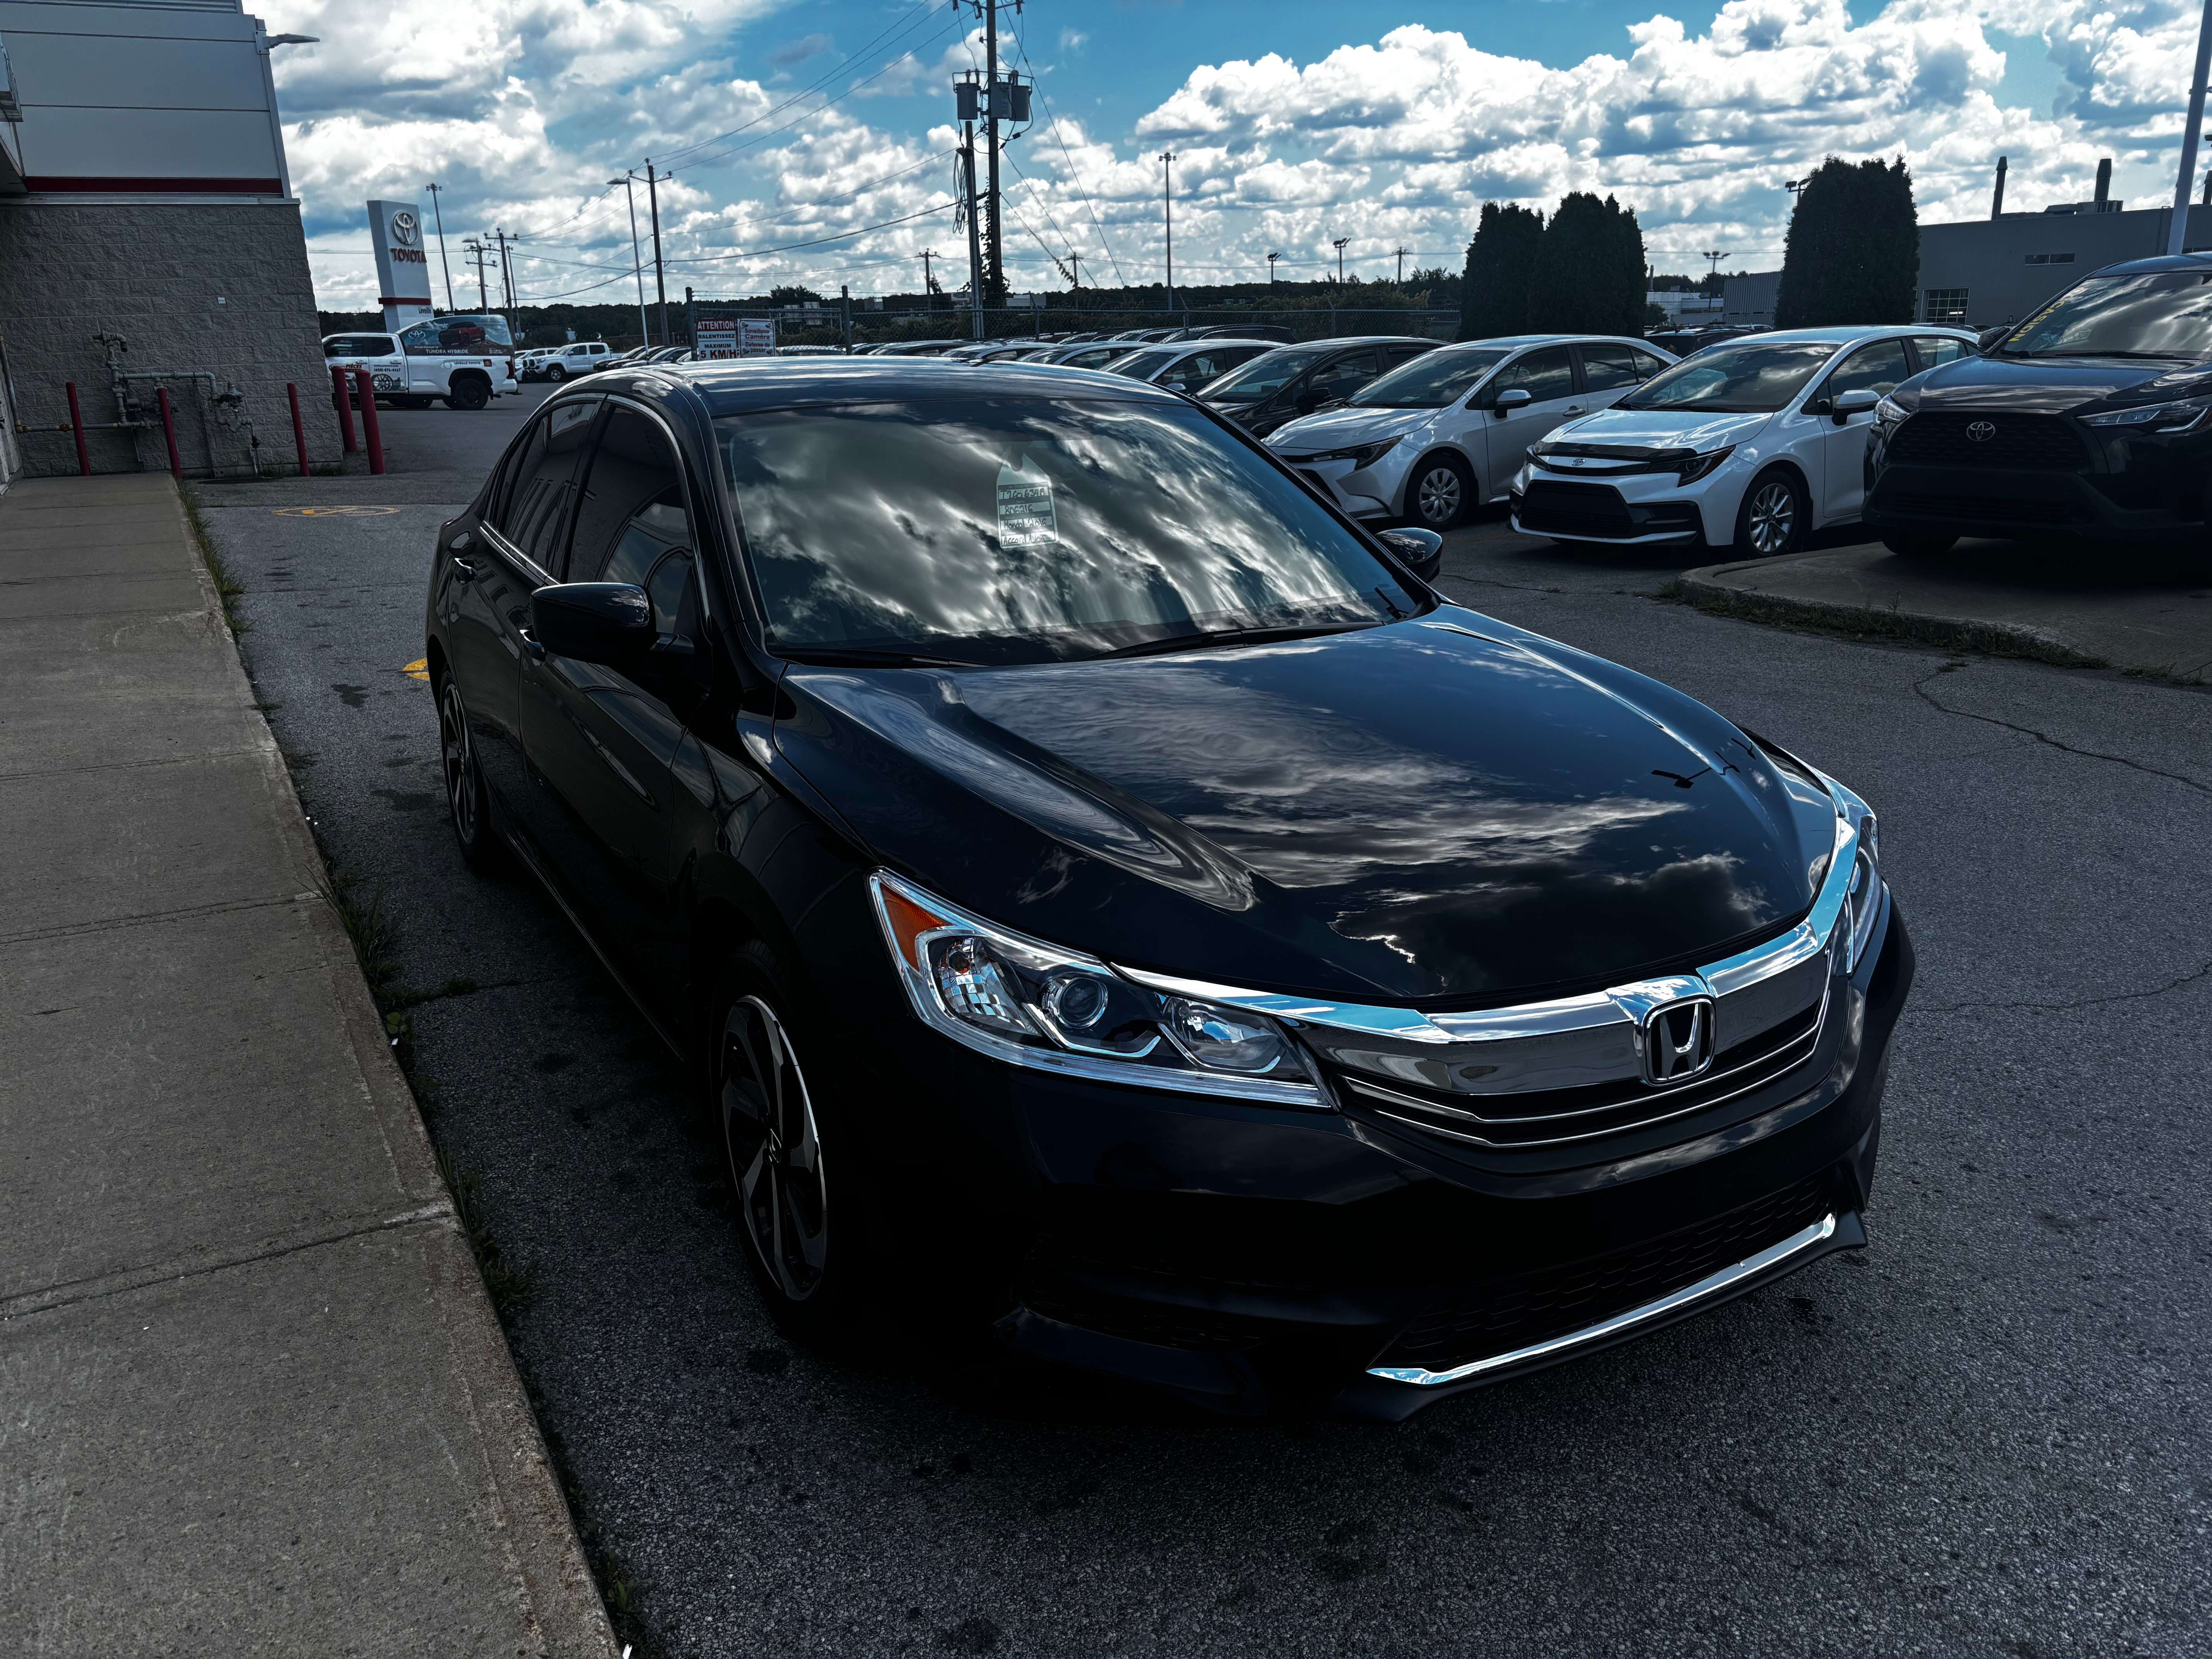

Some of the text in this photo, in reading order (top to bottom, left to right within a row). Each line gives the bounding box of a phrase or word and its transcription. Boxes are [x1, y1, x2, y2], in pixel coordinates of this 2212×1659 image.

[390, 248, 427, 263] TOYOTA
[697, 321, 735, 330] ATTENTION
[700, 349, 736, 359] 5 KM/H
[1005, 504, 1033, 514] 806216
